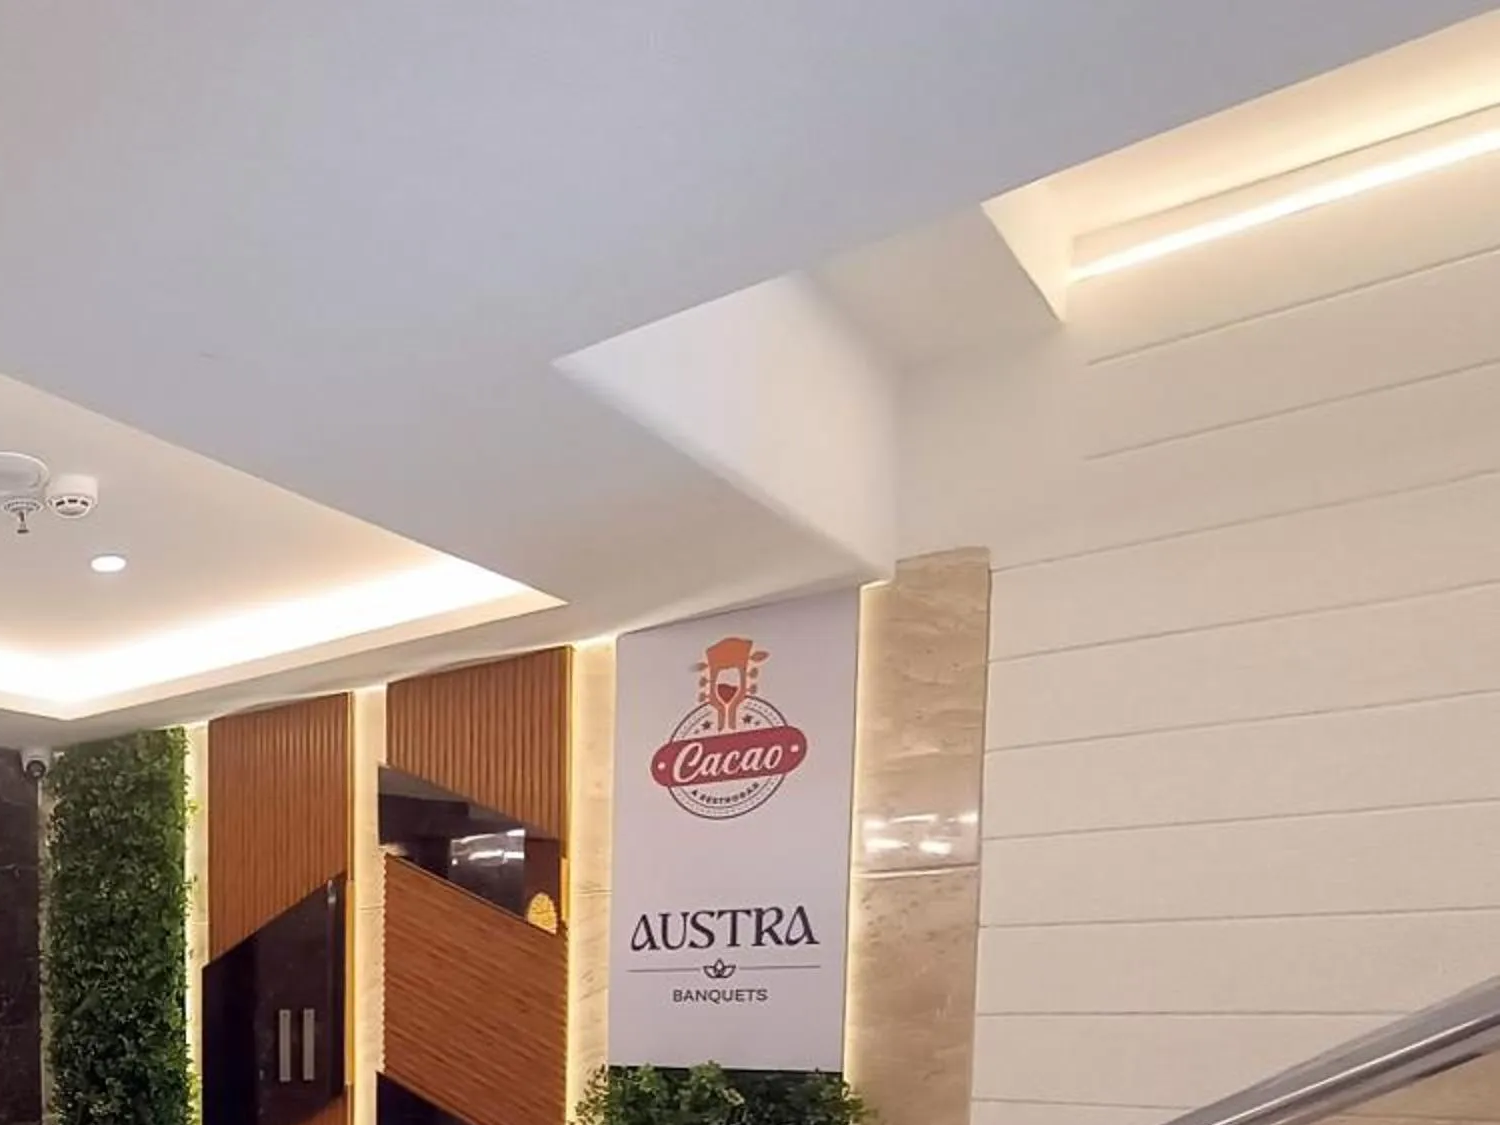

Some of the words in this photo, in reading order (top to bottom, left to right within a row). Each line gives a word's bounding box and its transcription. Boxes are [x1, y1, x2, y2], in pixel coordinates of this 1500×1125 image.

[673, 742, 783, 783] Cacao
[631, 905, 820, 951] AUSTRA
[673, 989, 768, 1004] BANQUETS
